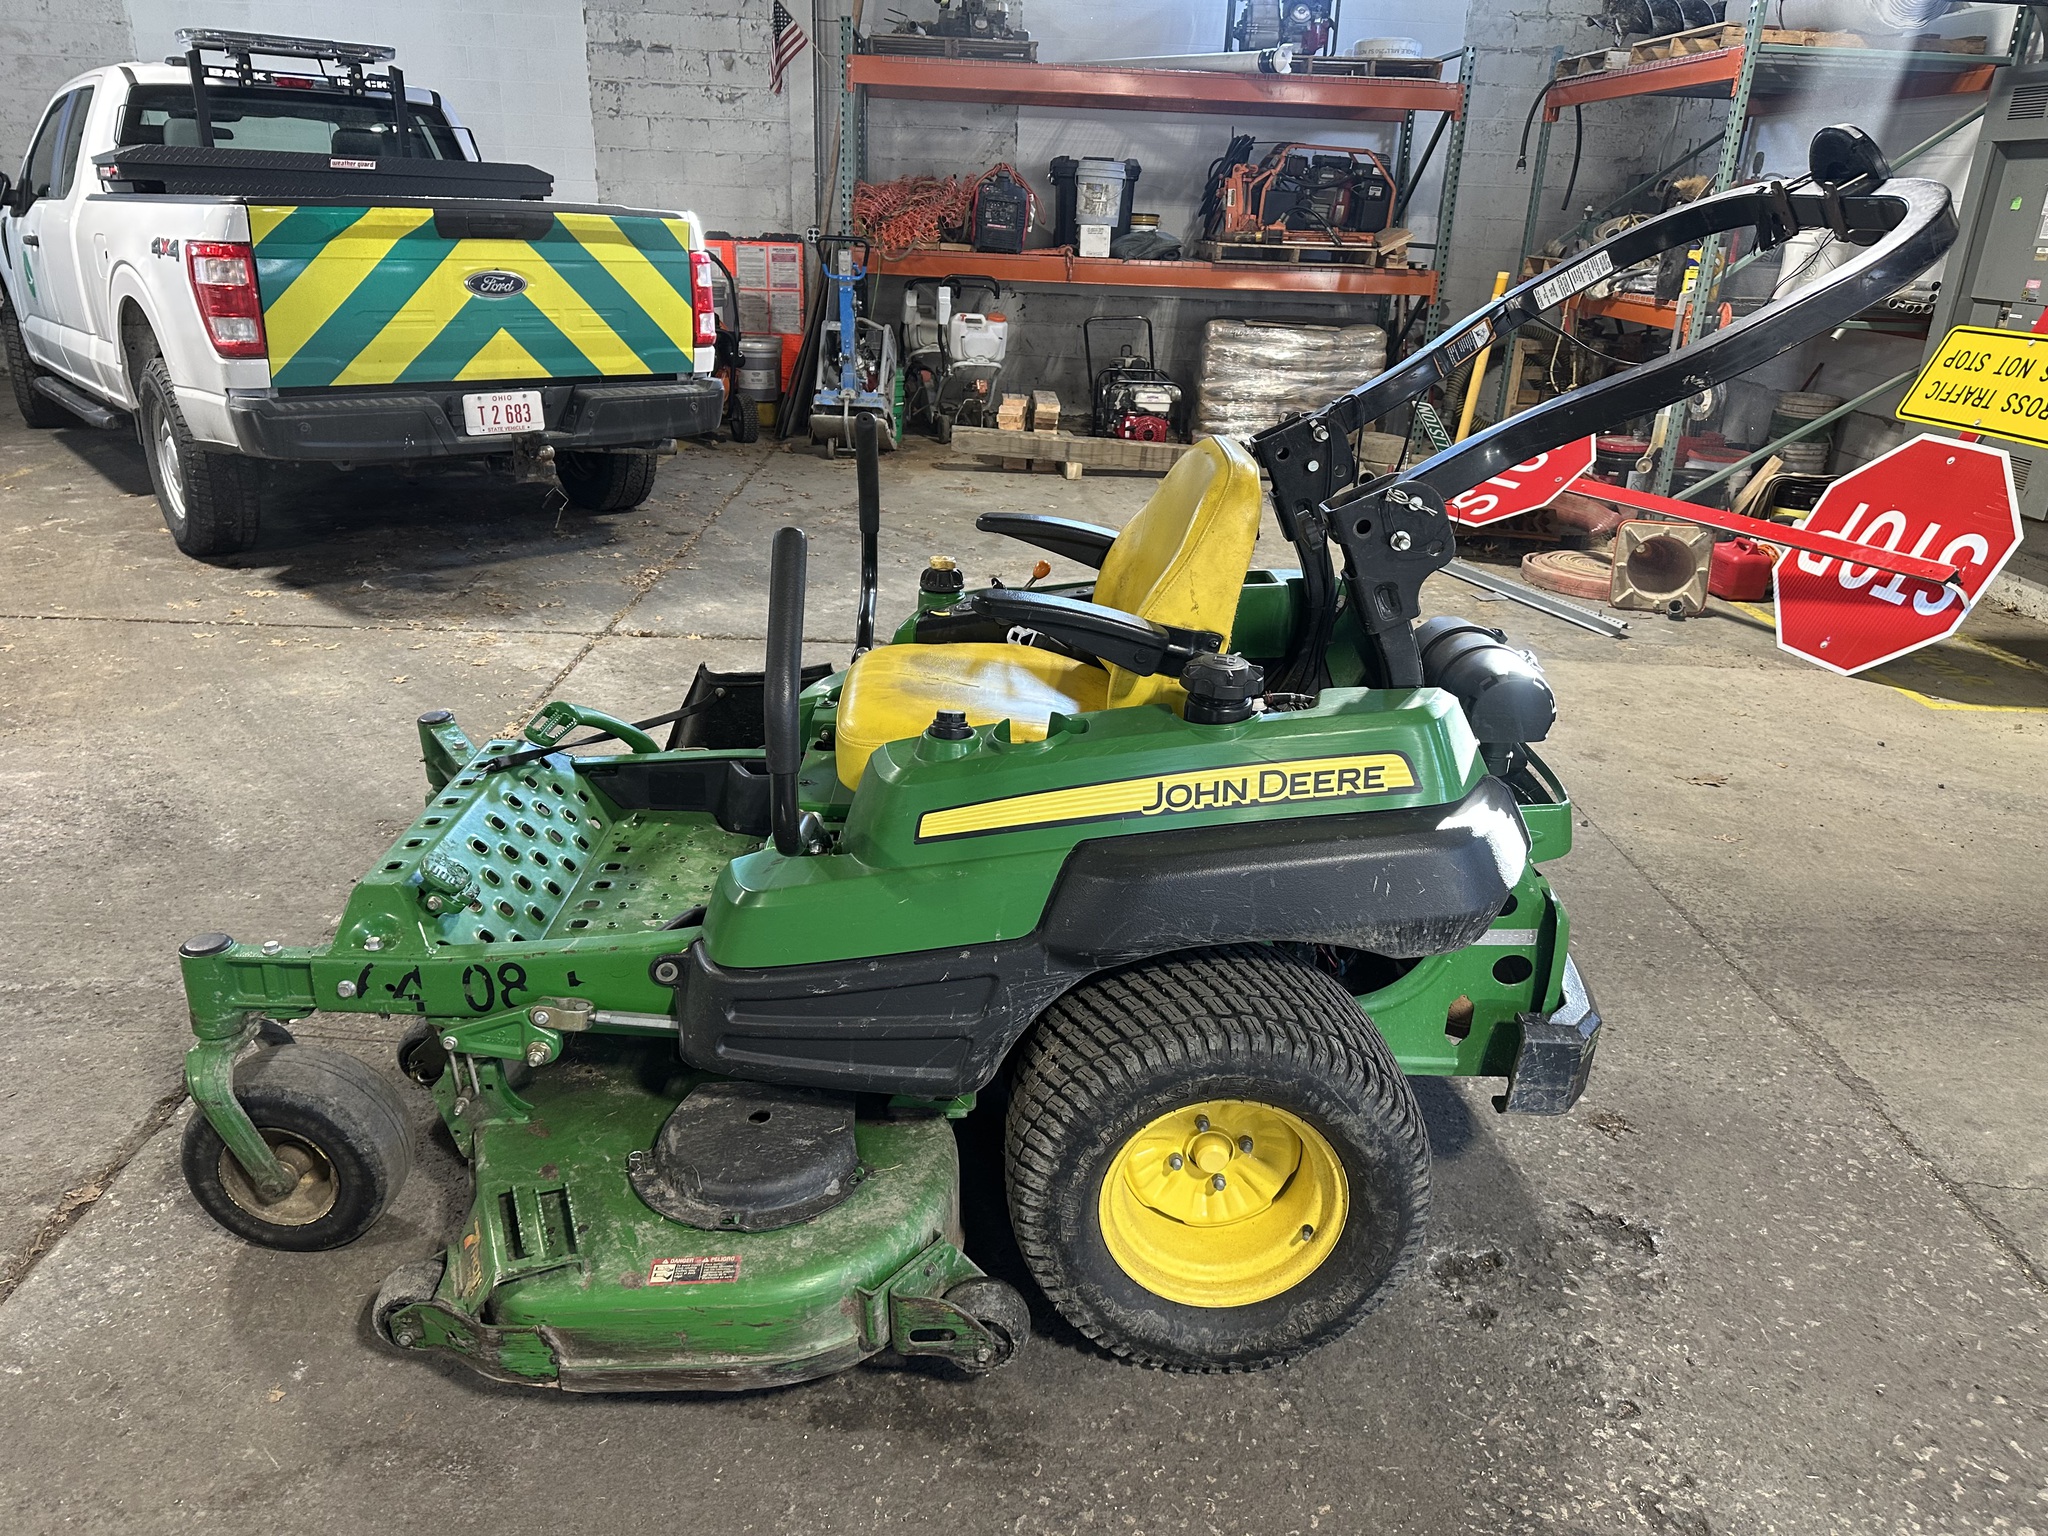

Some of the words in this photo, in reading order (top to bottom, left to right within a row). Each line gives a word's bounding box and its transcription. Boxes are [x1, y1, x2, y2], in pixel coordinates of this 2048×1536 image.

[208, 67, 267, 81] BAK
[336, 77, 391, 89] RCK
[480, 275, 515, 292] Ford
[1943, 349, 1992, 372] STOP
[1992, 355, 2038, 379] NOT
[492, 394, 513, 402] OHIO
[1925, 380, 1997, 410] TRAFFIC
[477, 405, 485, 426] T
[491, 405, 501, 425] 2
[505, 403, 532, 424] 683
[1797, 502, 1989, 617] STOP
[1142, 777, 1248, 812] JOHN
[1259, 765, 1386, 798] DEERE
[710, 1255, 736, 1263] PELIGRO
